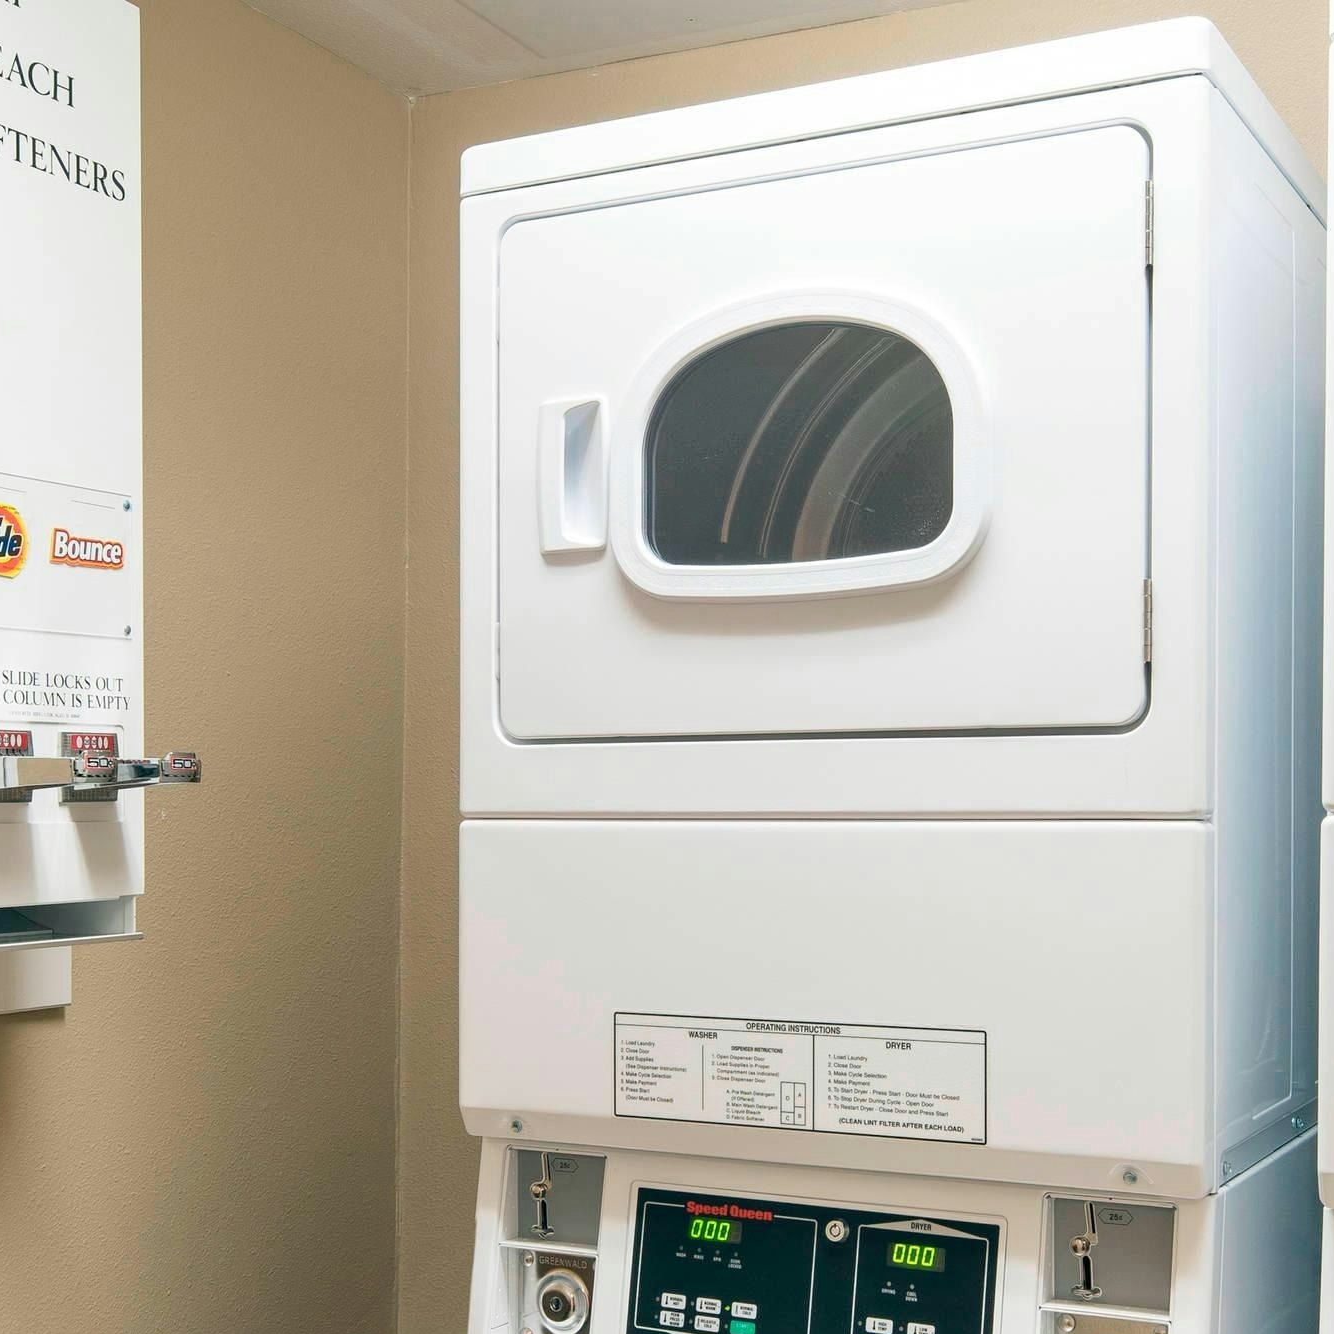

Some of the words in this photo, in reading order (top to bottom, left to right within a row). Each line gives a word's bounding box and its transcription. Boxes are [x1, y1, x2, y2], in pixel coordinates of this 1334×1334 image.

[55, 531, 121, 563] Bounce
[2, 670, 40, 686] SLIDE
[46, 673, 90, 689] LOCKS
[96, 677, 123, 692] OUT
[3, 690, 66, 707] COLUMN
[71, 694, 81, 708] IS
[87, 695, 130, 710] EMPTY
[689, 1031, 717, 1039] WASHER
[746, 1023, 786, 1031] OPERATING
[788, 1024, 840, 1034] INSTRUCTIONS
[886, 1042, 911, 1050] DRYER
[839, 1117, 862, 1125] (CLEAN
[686, 1201, 728, 1217] Speed
[730, 1205, 774, 1221] Queen
[691, 1219, 730, 1241] 000
[911, 1222, 932, 1232] DRYER
[539, 1255, 588, 1269] GREENWALD
[892, 1243, 935, 1267] 000
